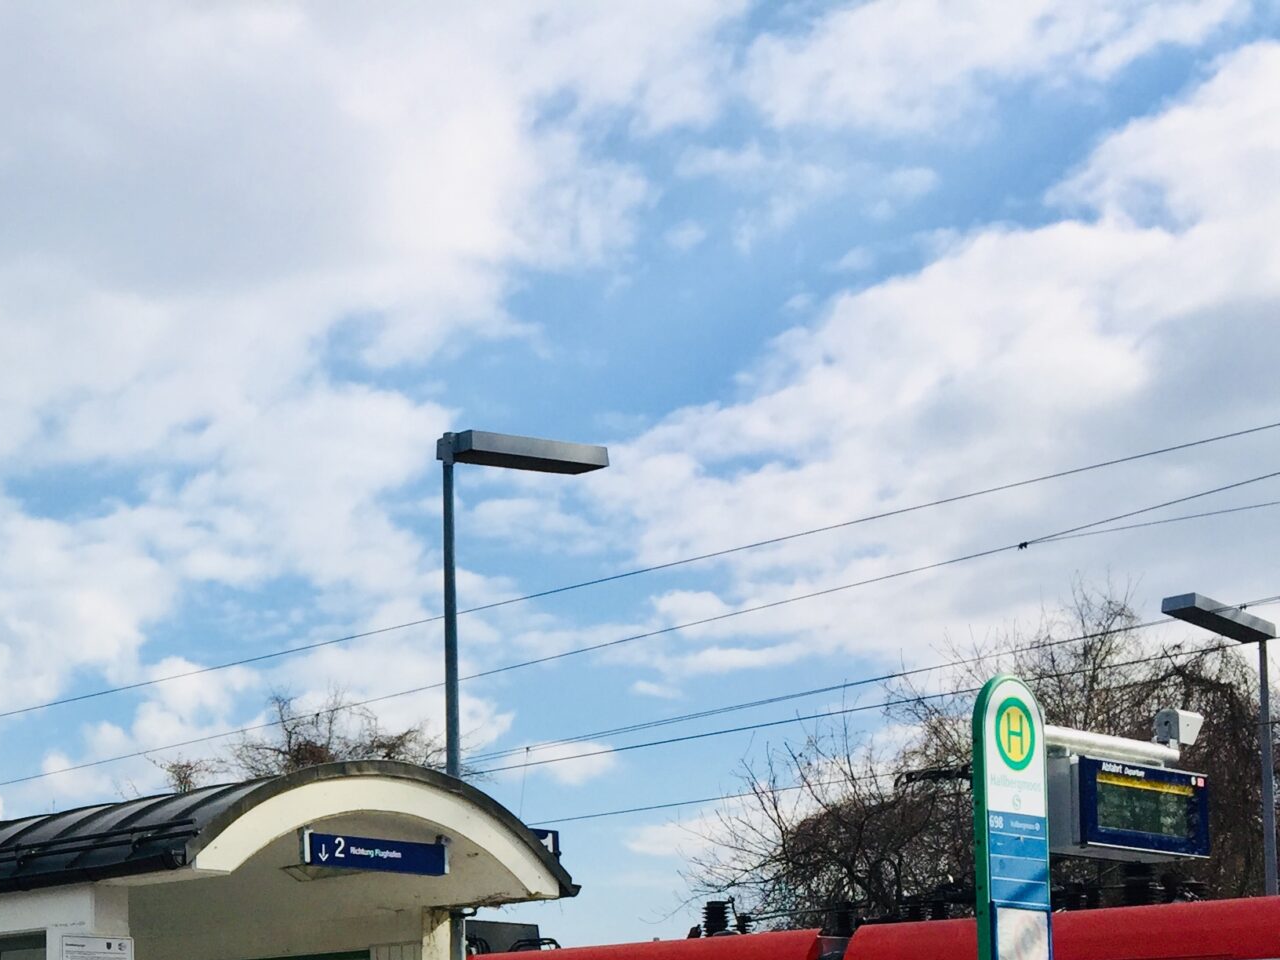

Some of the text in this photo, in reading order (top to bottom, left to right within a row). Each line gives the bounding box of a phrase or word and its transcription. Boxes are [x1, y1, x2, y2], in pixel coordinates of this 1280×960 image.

[1006, 711, 1024, 756] H
[989, 815, 1004, 829] 698
[334, 837, 402, 858] 2 Richtung Flughafen
